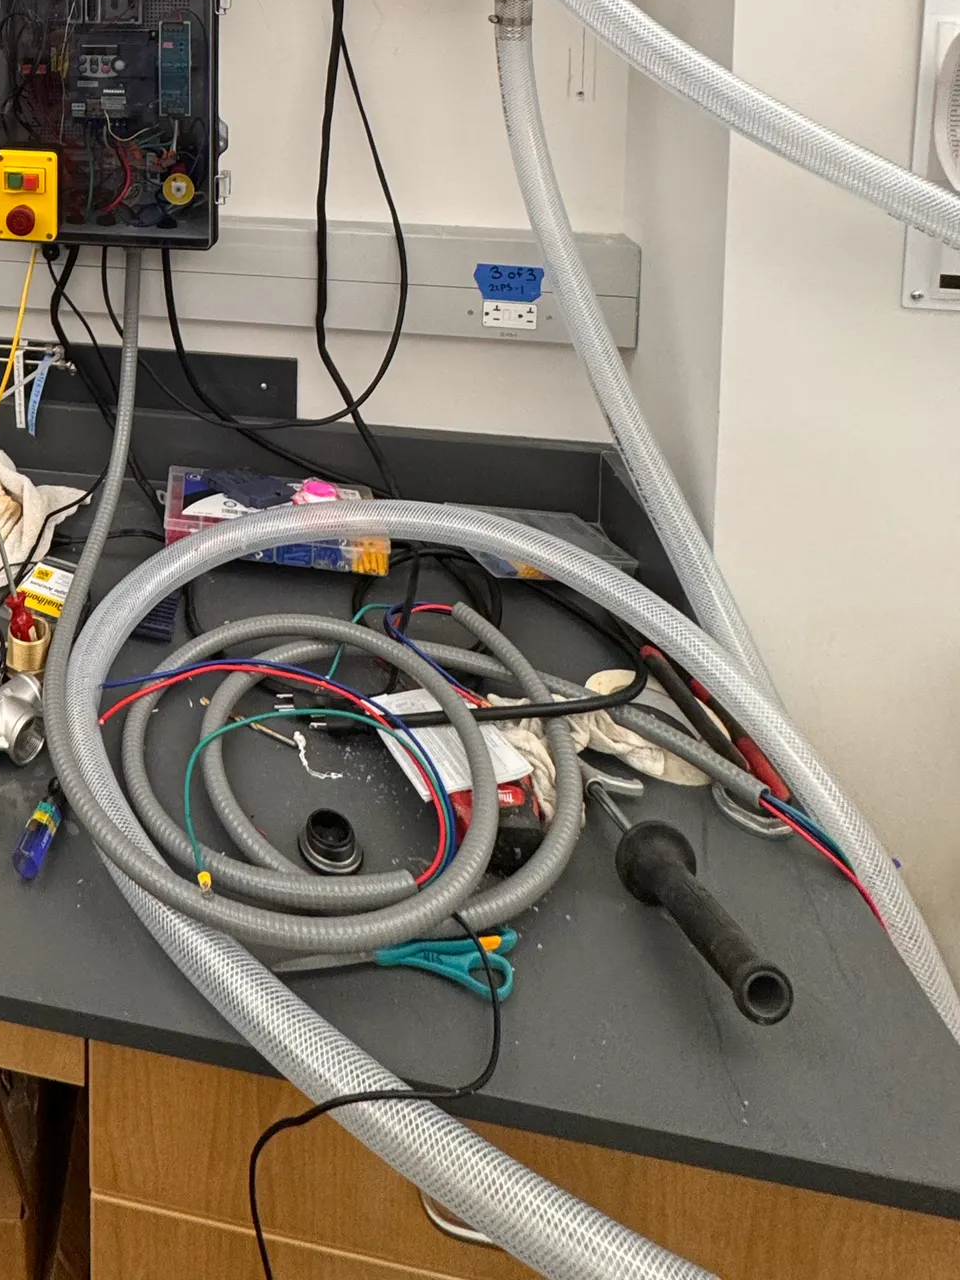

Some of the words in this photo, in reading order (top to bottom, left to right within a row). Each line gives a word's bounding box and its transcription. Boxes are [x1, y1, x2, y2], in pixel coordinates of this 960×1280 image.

[490, 266, 503, 280] 3
[508, 267, 523, 280] of
[525, 268, 537, 282] 3
